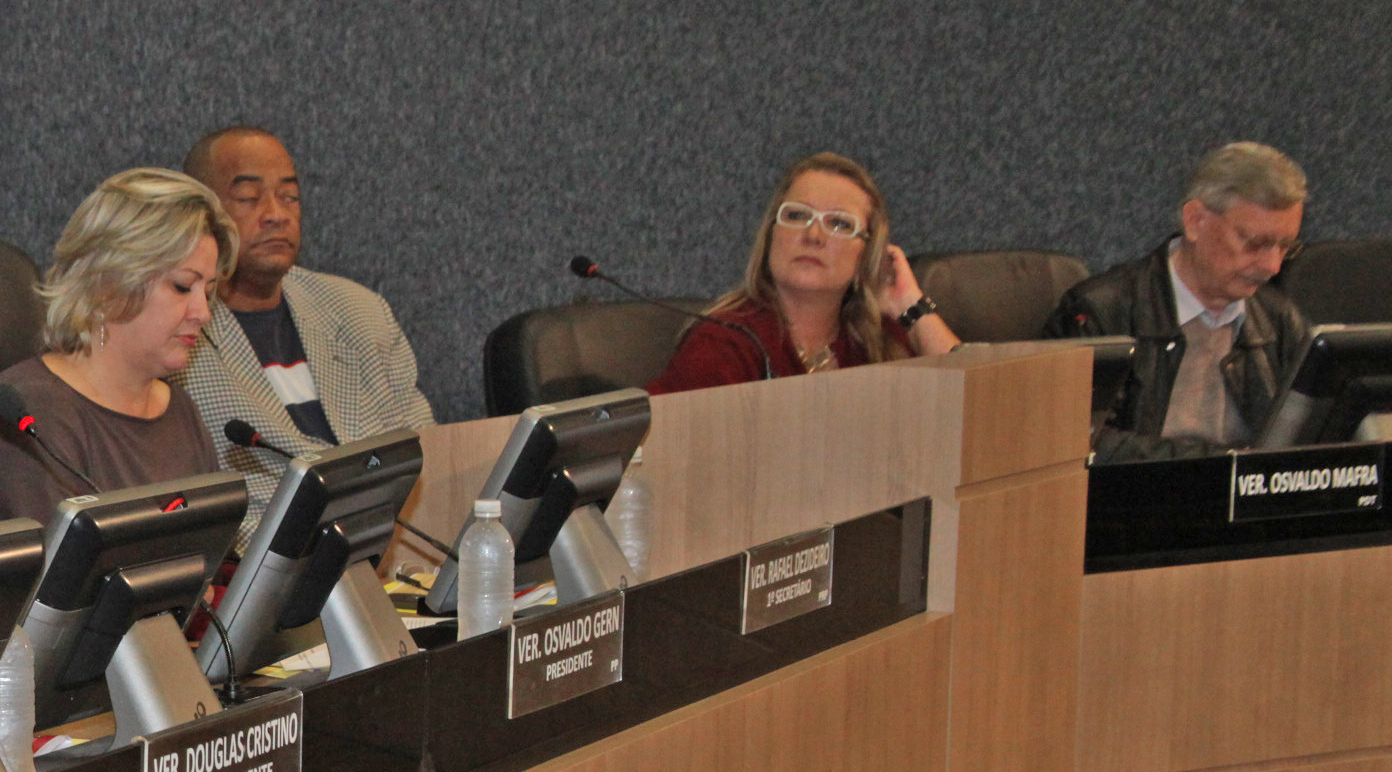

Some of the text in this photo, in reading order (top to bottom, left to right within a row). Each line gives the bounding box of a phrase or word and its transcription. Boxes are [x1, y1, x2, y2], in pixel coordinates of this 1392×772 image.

[1238, 463, 1379, 497] VER. OSVALDO MAFRA
[751, 563, 767, 590] VER.
[768, 554, 794, 584] RAFAEL
[518, 605, 620, 664] VER. OSVALDO GERN
[546, 649, 593, 682] PRESIDENTE
[186, 730, 244, 772] DOUGLAS
[246, 712, 298, 759] CRISTINO
